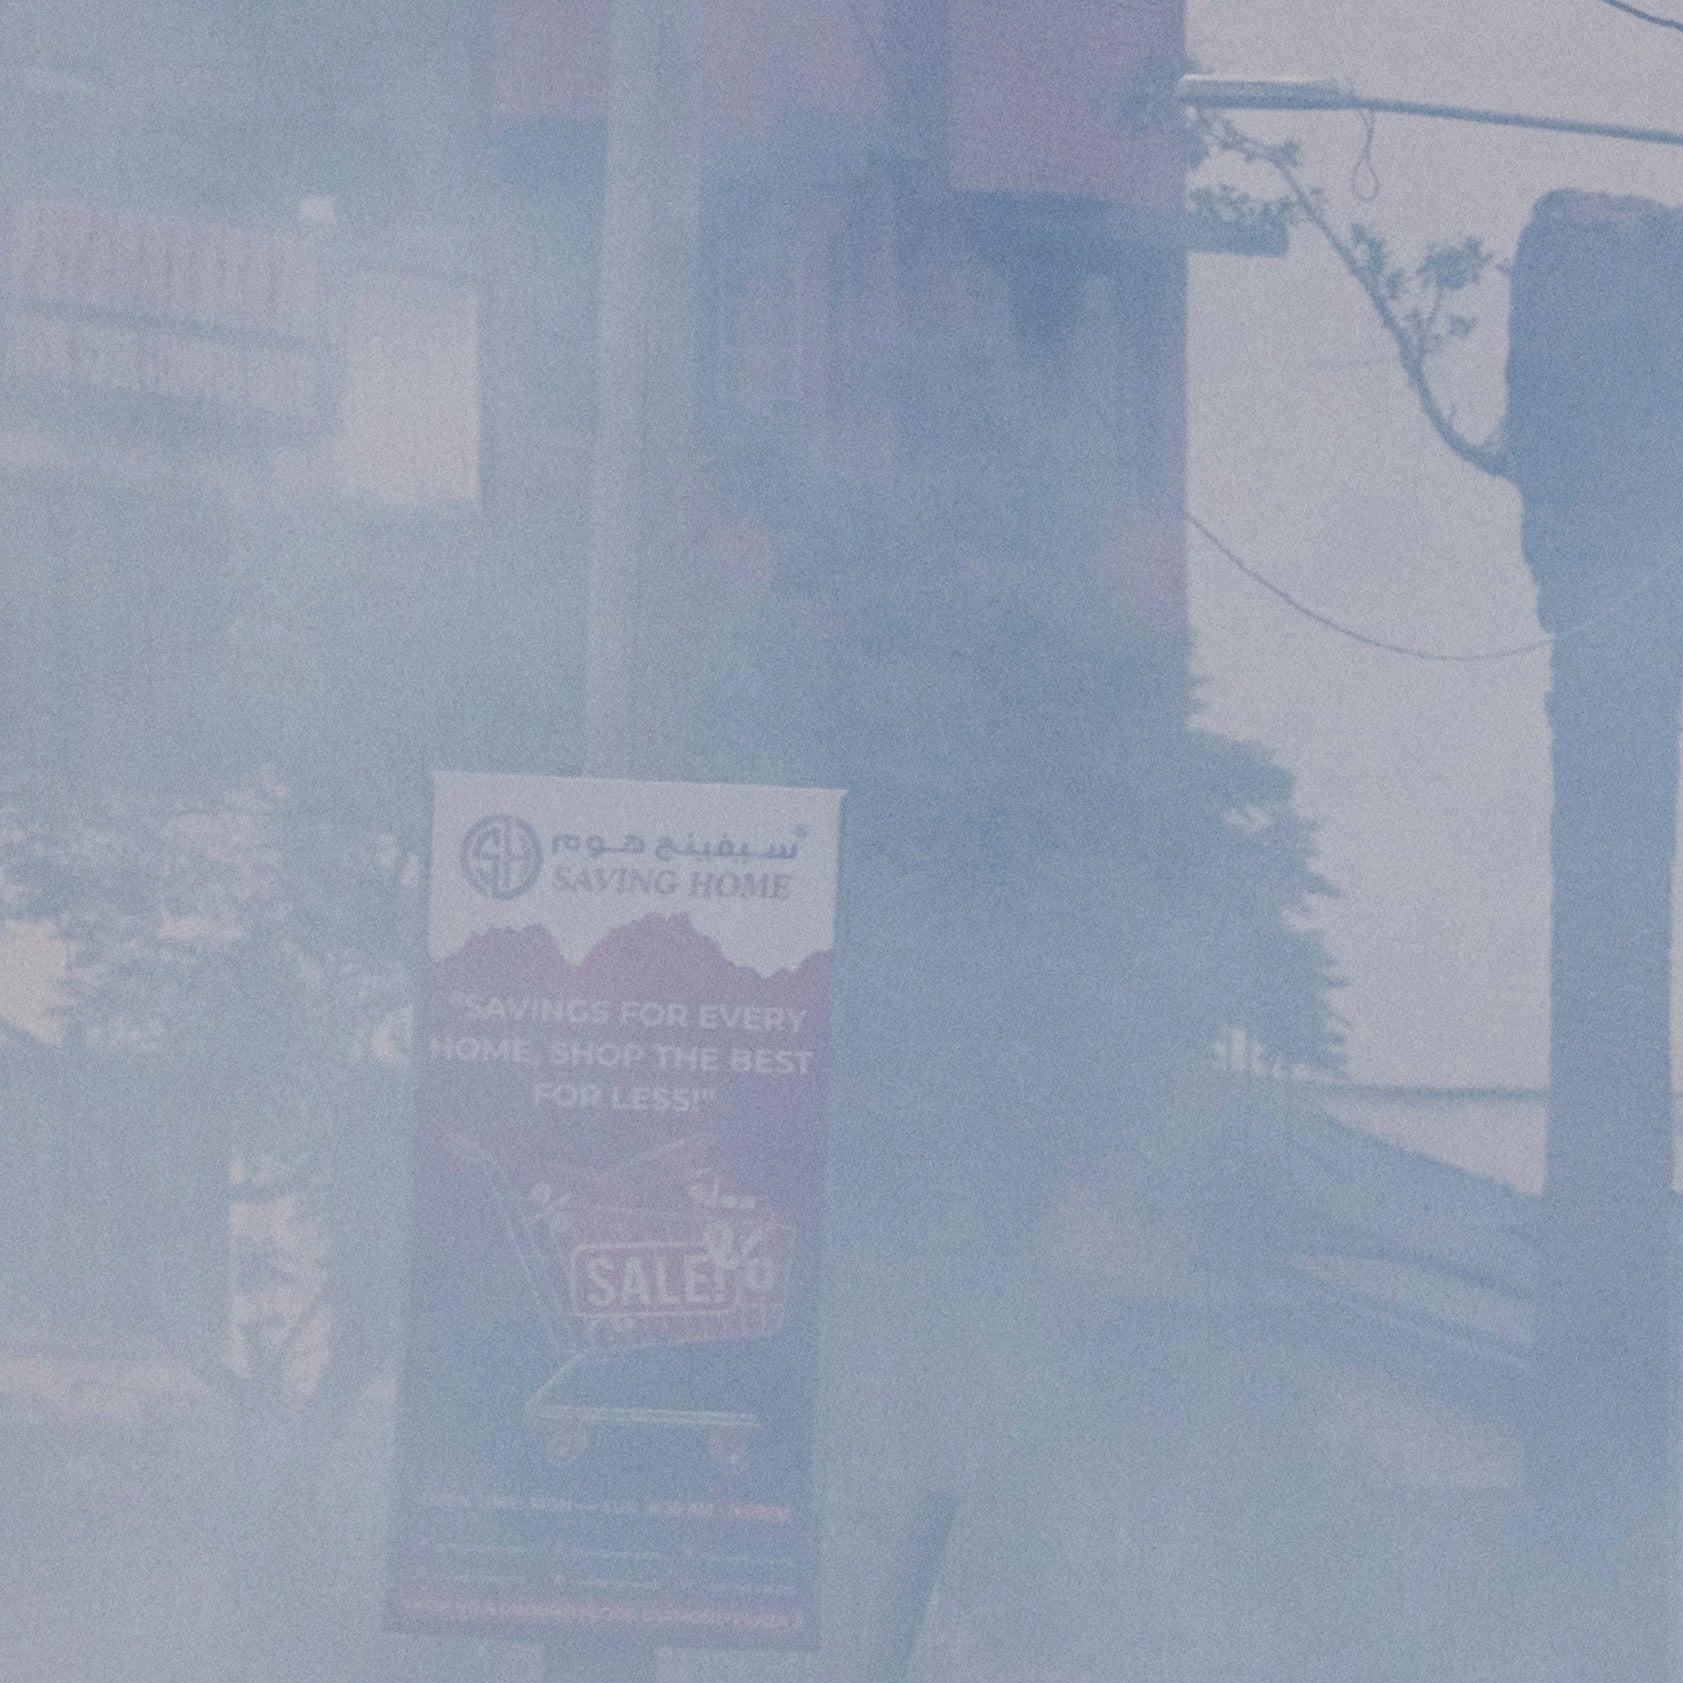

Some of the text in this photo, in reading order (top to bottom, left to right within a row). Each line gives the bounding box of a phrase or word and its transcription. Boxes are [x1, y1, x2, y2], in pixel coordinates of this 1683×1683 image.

[552, 864, 795, 900] SAVING HOME
[620, 1001, 688, 1028] FOR
[698, 1004, 808, 1034] EVERY
[549, 1041, 645, 1068] SHOP
[654, 1044, 720, 1072] THE
[729, 1048, 815, 1076] BEST
[532, 1081, 602, 1108] FOR
